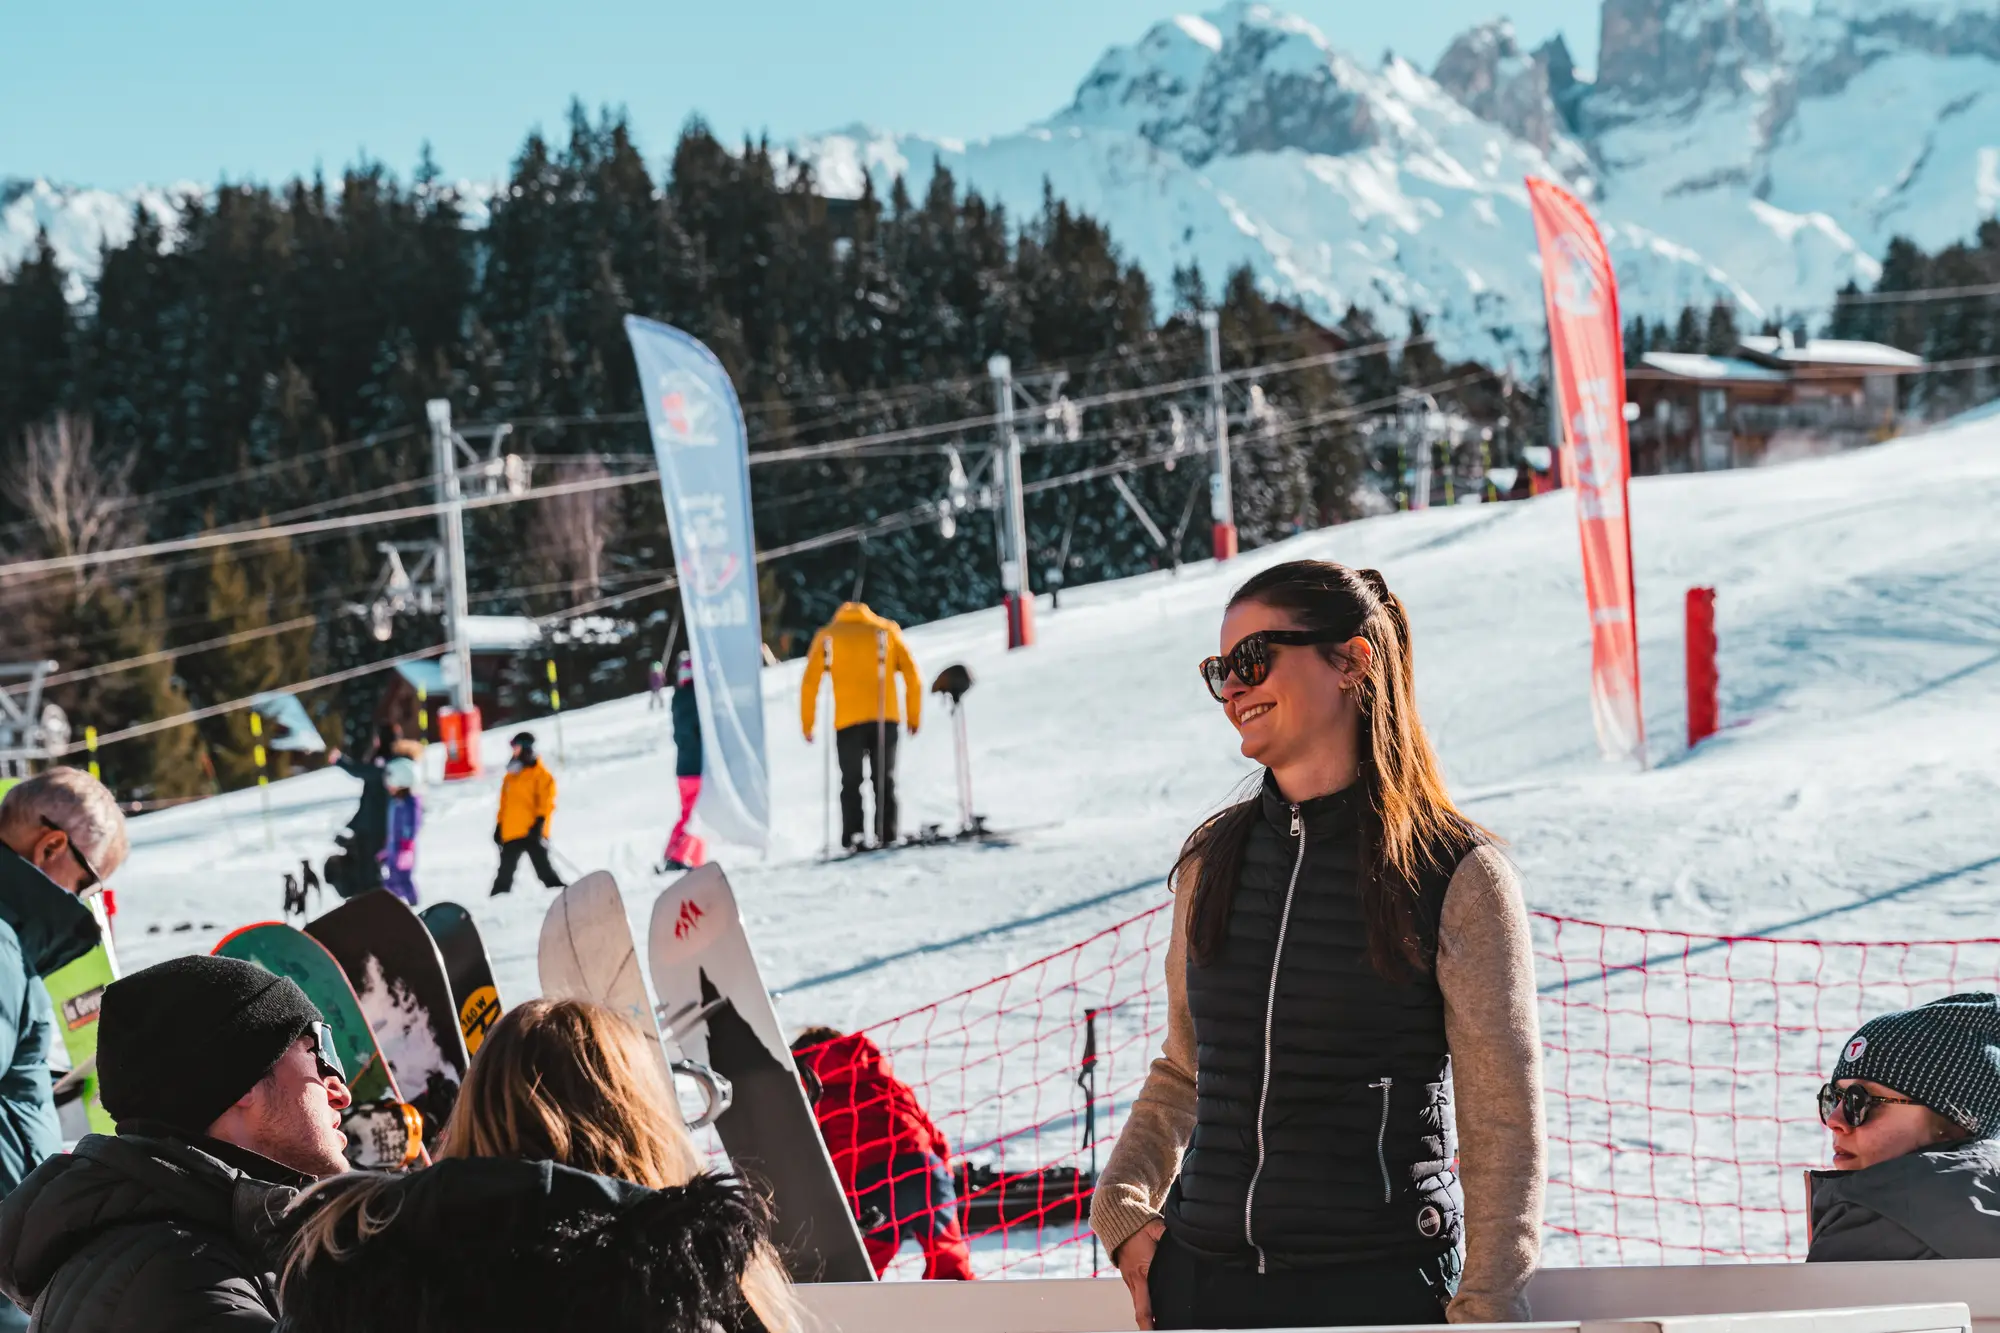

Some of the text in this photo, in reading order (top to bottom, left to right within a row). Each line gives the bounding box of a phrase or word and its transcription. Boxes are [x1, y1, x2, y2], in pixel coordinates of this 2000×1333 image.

[461, 995, 487, 1028] 160 W
[1851, 1042, 1862, 1056] T
